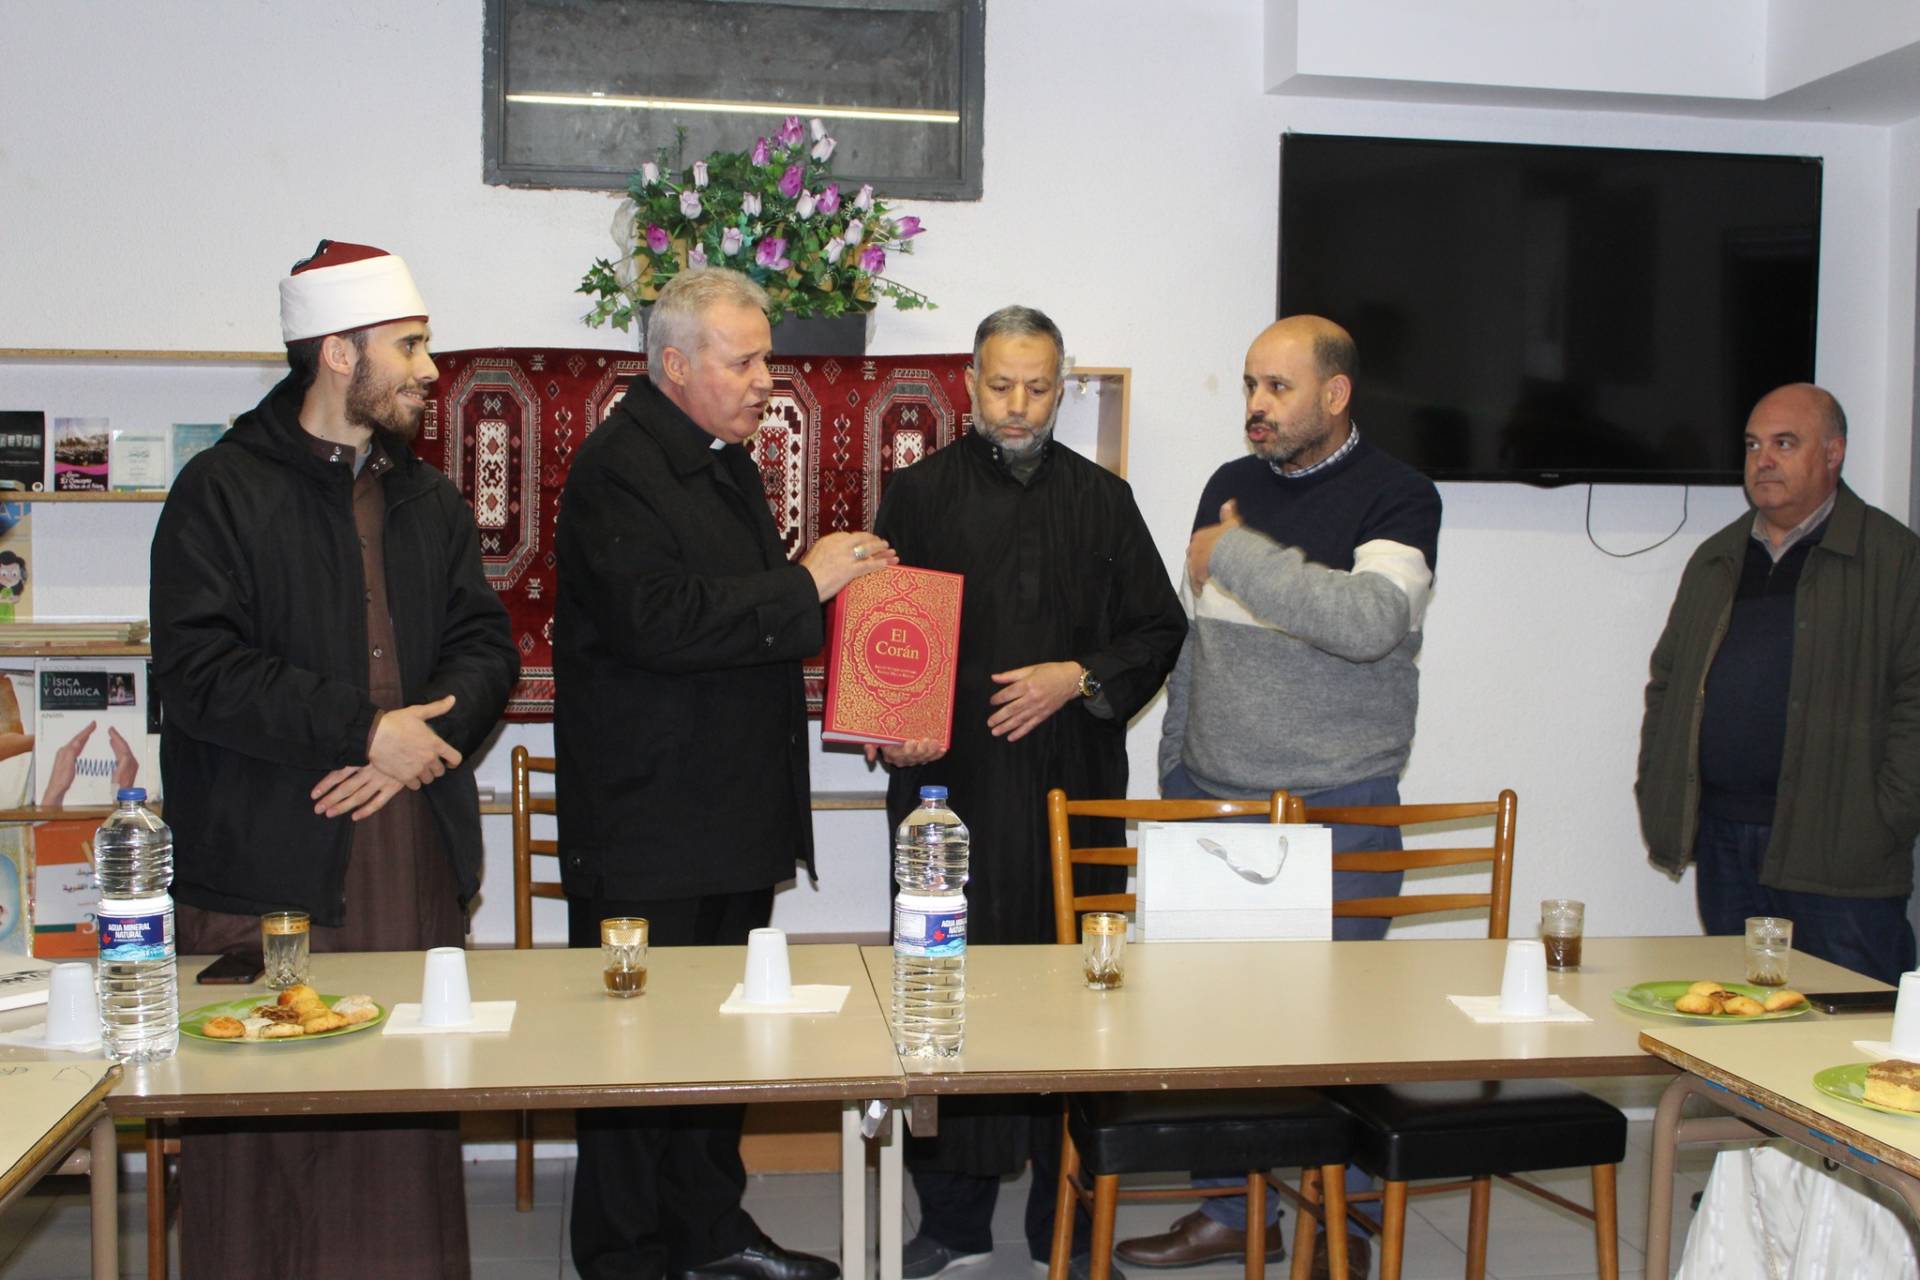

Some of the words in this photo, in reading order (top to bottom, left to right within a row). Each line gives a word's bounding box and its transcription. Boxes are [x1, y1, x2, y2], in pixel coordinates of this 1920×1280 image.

[892, 629, 907, 643] El
[876, 641, 919, 659] Corán
[43, 687, 50, 696] Y
[53, 686, 100, 697] QUÍMICA
[82, 912, 97, 934] 3
[115, 930, 143, 938] NATURAL
